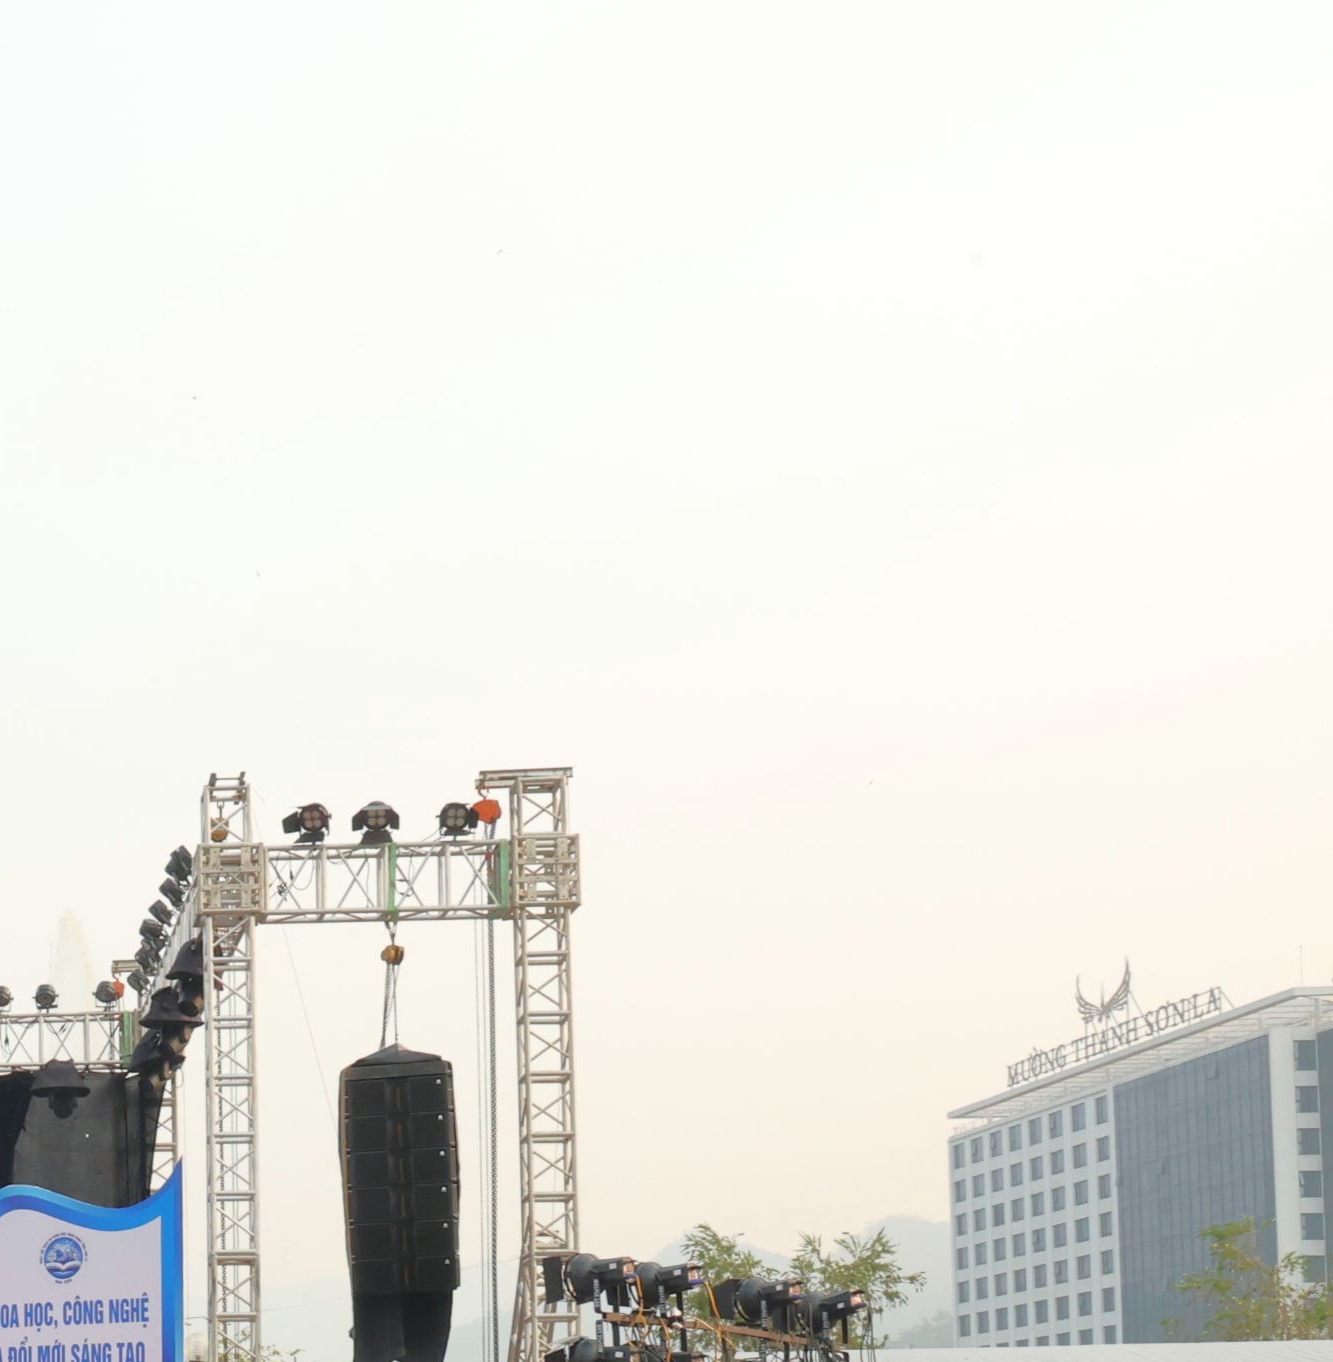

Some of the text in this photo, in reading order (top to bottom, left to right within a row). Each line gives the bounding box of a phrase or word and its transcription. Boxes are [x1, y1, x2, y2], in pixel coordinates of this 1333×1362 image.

[1071, 1018, 1139, 1063] THANH
[1193, 987, 1222, 1018] LA
[24, 1302, 58, 1332] HỌC,
[63, 1295, 104, 1325] CÔNG
[109, 1292, 149, 1328] NGHỆ
